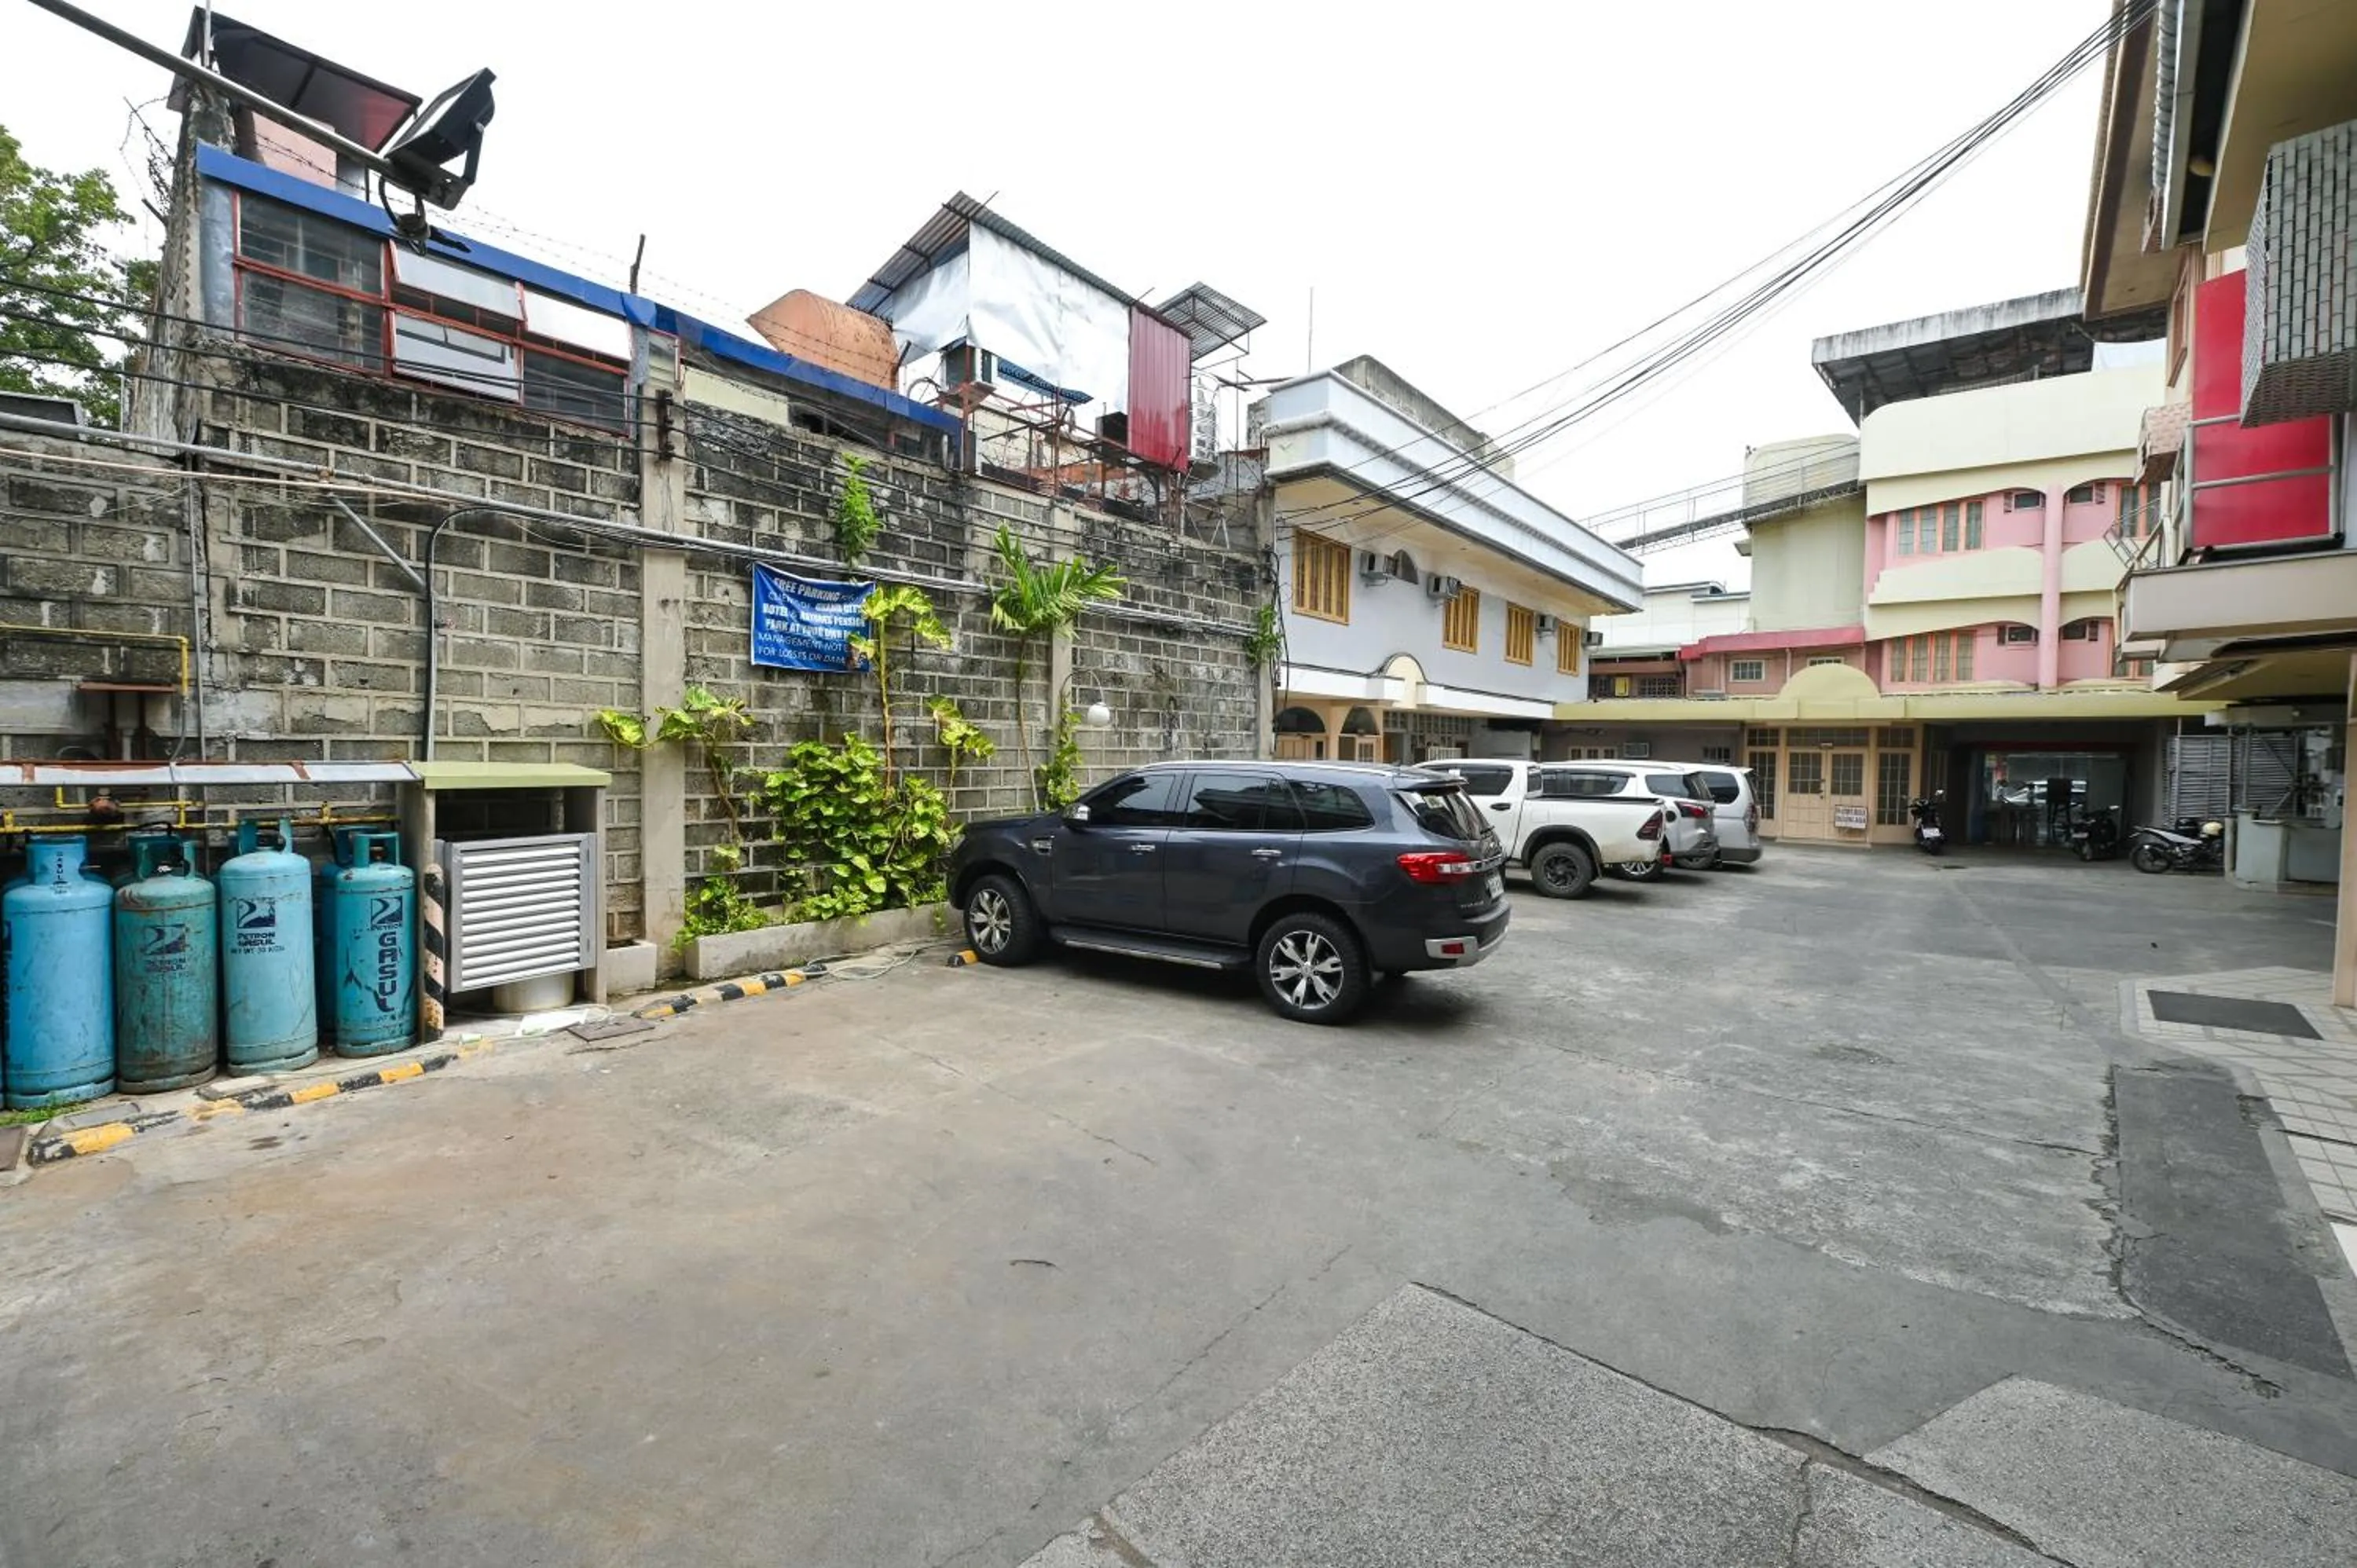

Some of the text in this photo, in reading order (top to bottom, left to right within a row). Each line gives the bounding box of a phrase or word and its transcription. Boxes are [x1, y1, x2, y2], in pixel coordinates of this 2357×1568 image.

[772, 577, 797, 593] FREE
[798, 584, 840, 602] PARKING
[763, 603, 788, 617] HOTEL
[765, 617, 788, 632] PARK
[789, 621, 800, 632] AT
[758, 632, 823, 650] MANAGEMENT
[824, 640, 842, 651] NOT
[758, 647, 775, 656] FOR
[377, 932, 398, 1012] GASUL
